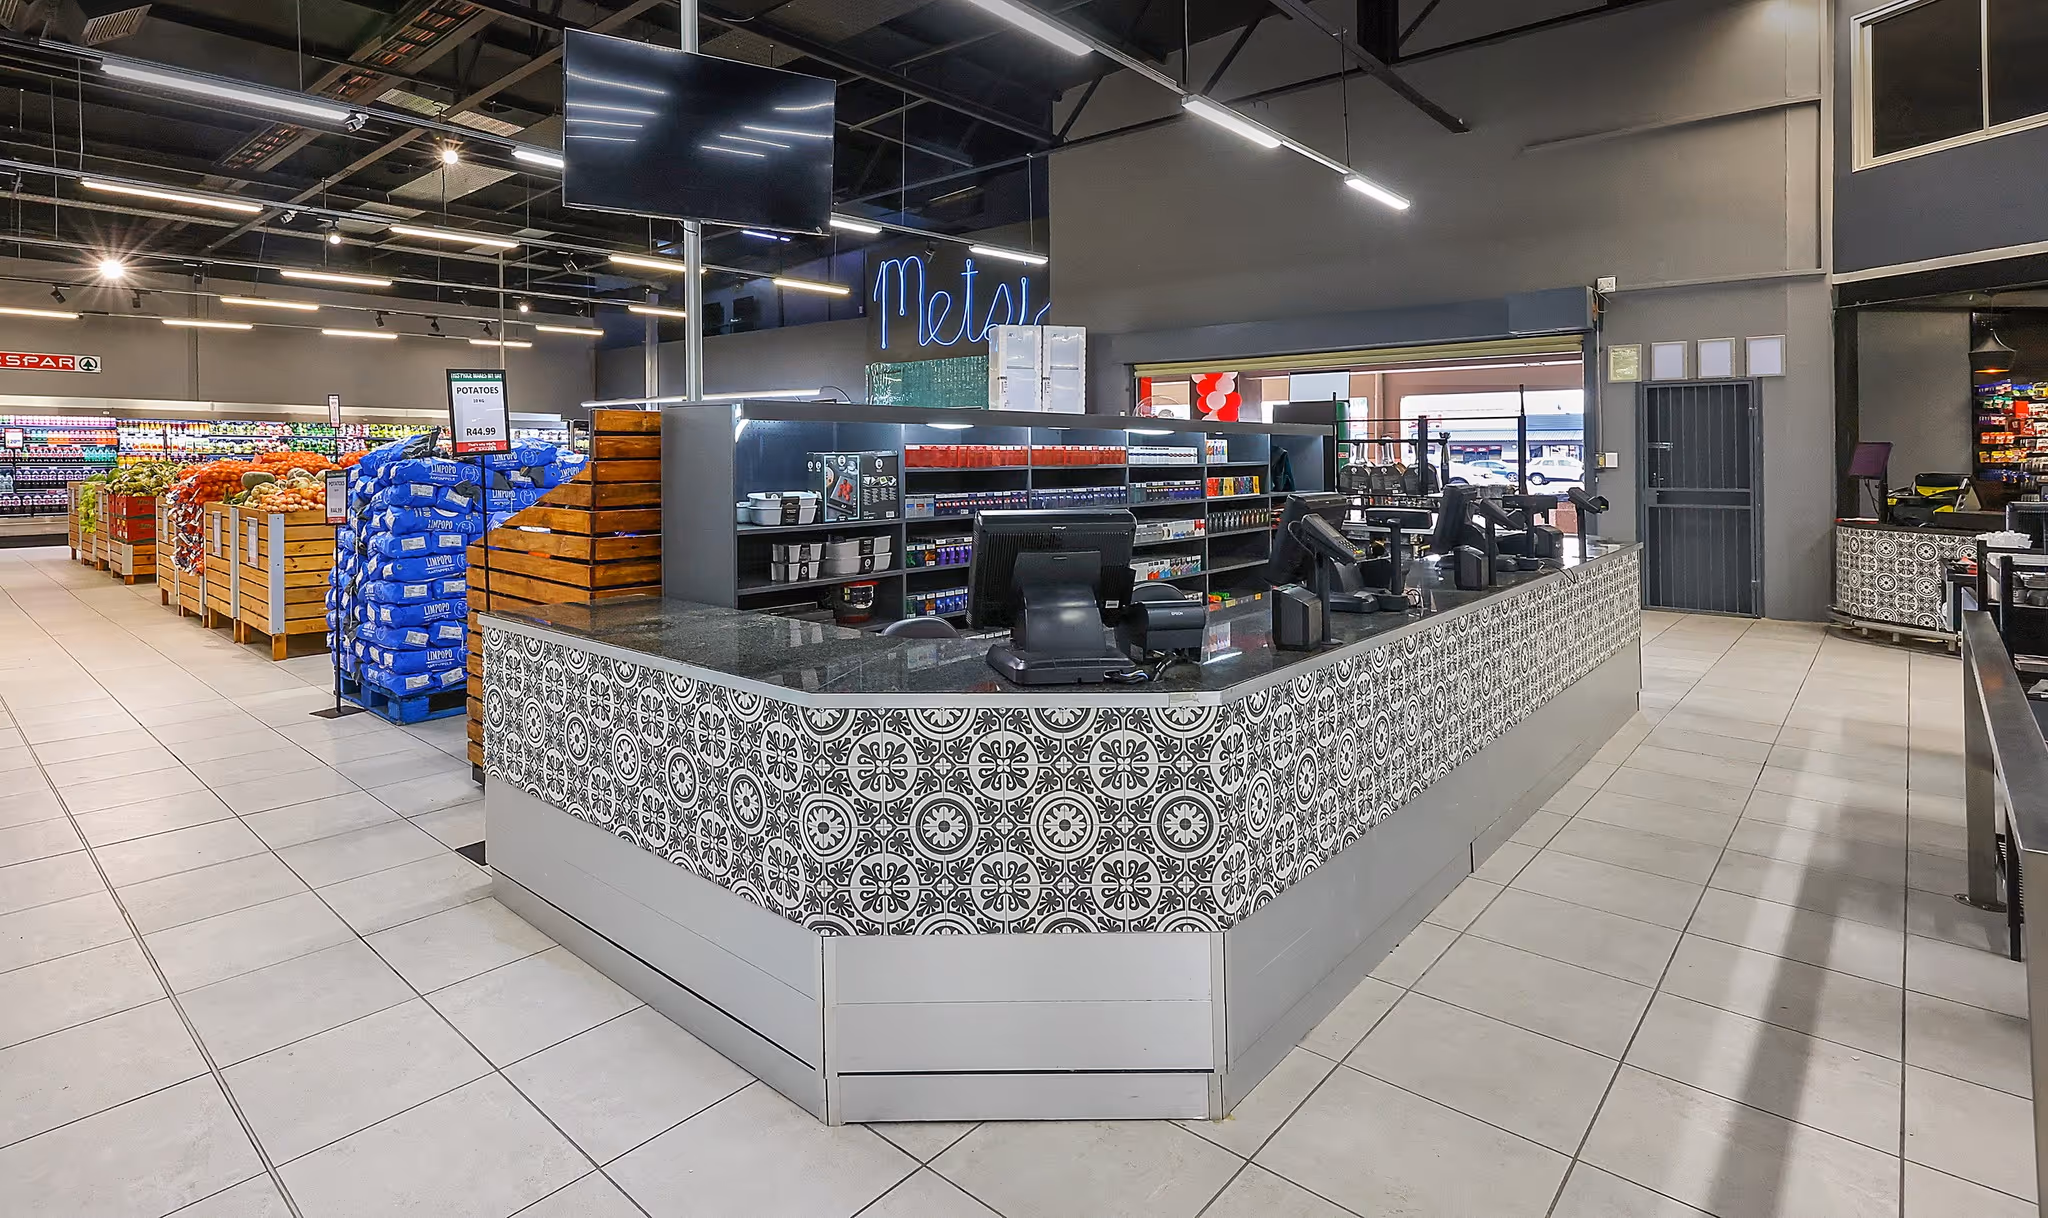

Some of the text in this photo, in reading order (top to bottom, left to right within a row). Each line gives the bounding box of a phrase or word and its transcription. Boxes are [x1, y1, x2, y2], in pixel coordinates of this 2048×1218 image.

[0, 355, 73, 368] SPAR
[456, 386, 499, 395] POTATOES
[466, 427, 496, 437] R44.99
[492, 452, 518, 462] LIMPOPO
[430, 464, 457, 475] LIMPOPO
[492, 489, 516, 499] LIMPOPO
[427, 519, 453, 529] LIMPOPO
[425, 554, 453, 568] LIMPOPO
[423, 602, 450, 616] LIMPOPO
[426, 648, 453, 661] LIMPOPO
